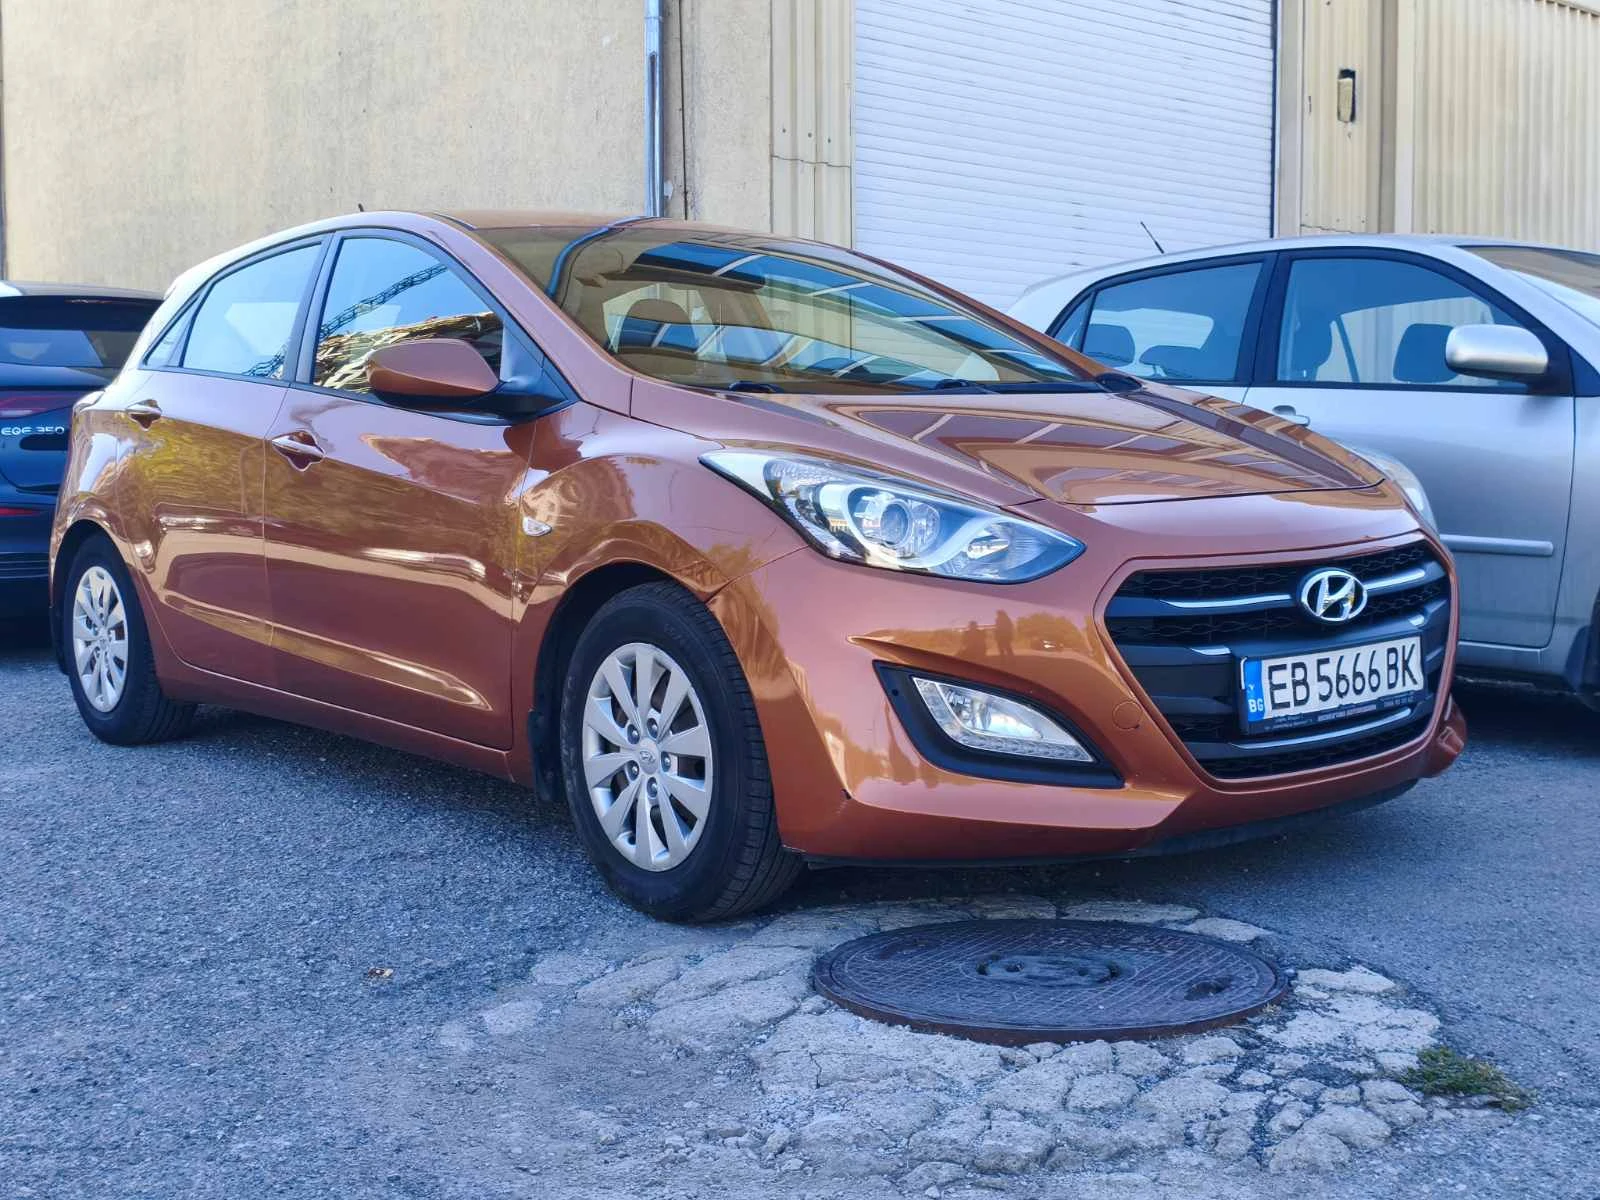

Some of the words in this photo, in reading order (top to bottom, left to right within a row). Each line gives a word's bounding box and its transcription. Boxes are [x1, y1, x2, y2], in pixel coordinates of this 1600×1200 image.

[1268, 661, 1310, 710] EB
[1316, 650, 1381, 702] 5666
[1386, 643, 1418, 690] BK
[1248, 698, 1264, 713] BG
